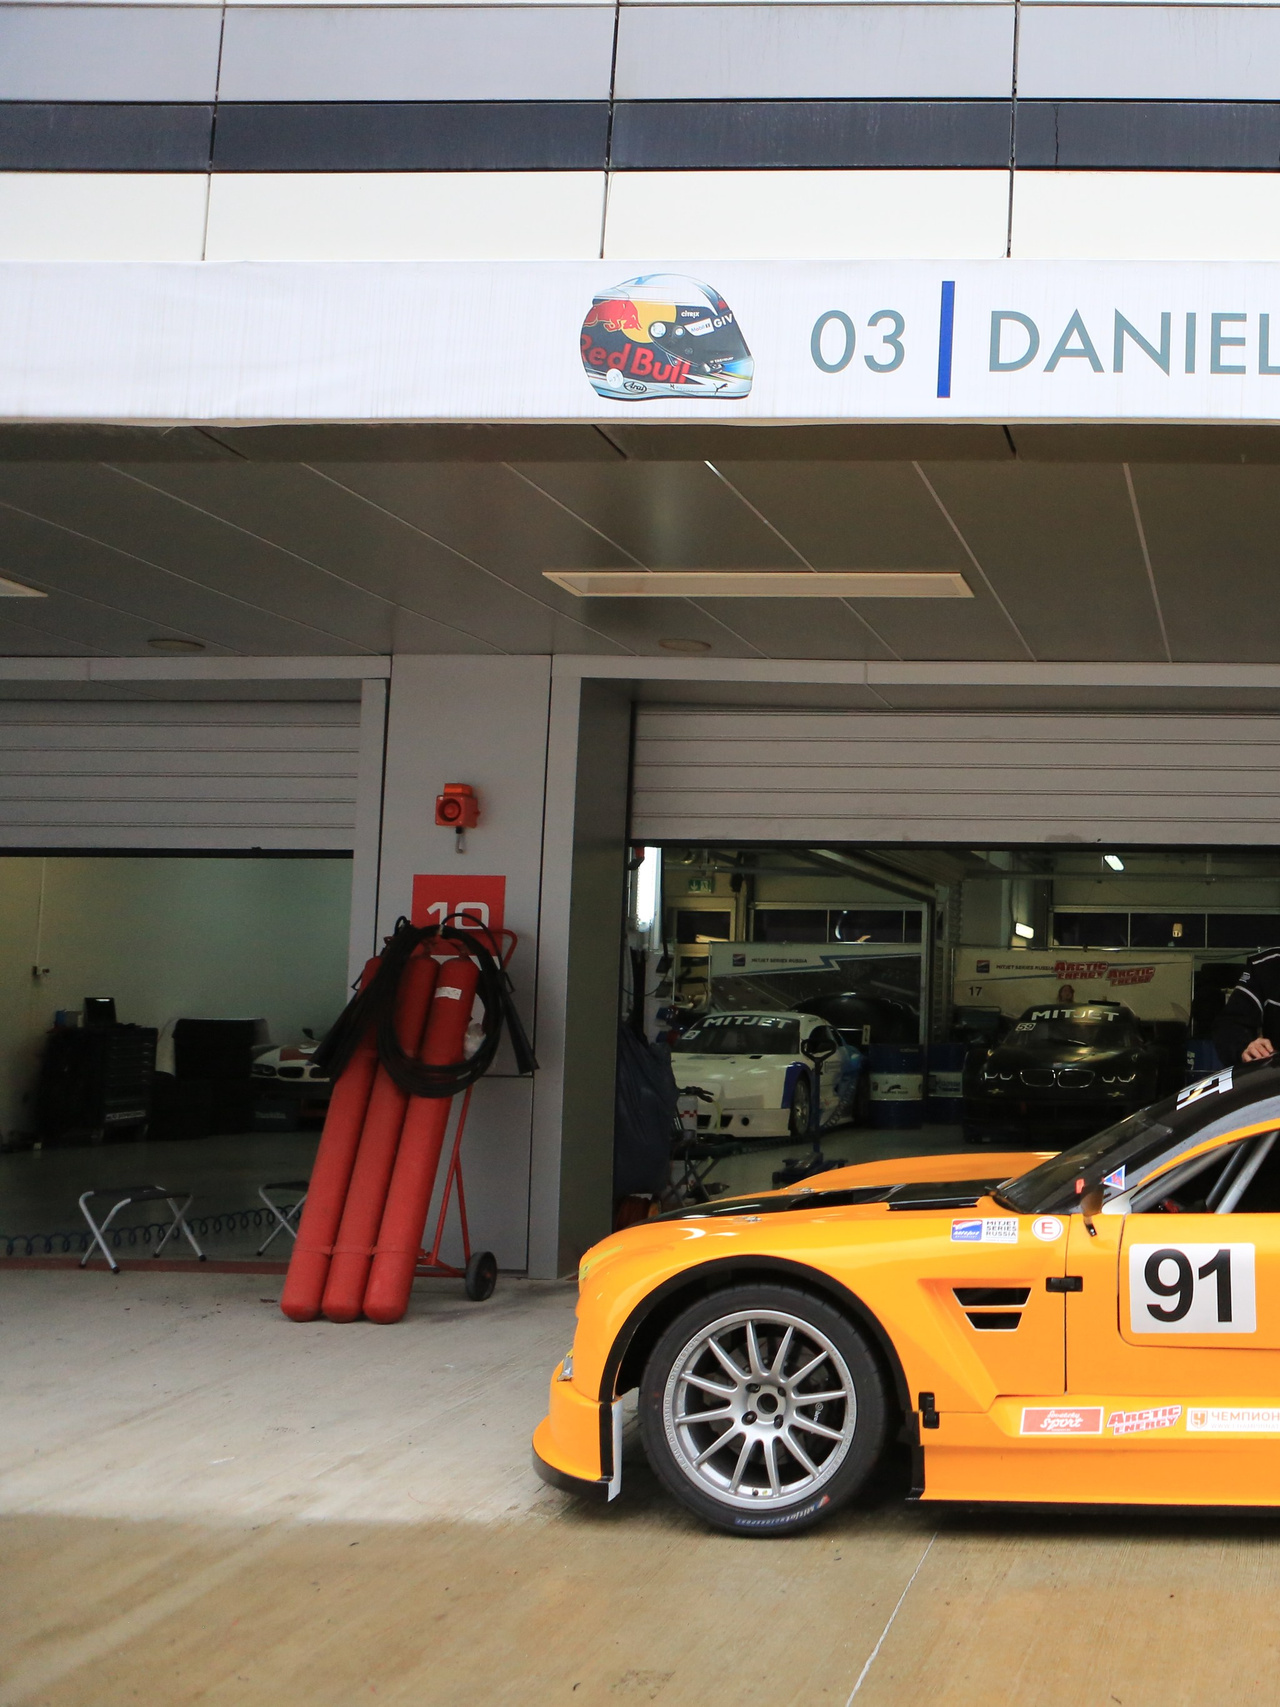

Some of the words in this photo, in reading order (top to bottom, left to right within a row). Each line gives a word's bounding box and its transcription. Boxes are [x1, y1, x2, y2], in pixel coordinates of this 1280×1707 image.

[713, 314, 733, 328] GIV
[810, 309, 906, 374] 03
[629, 347, 692, 384] Bull
[426, 901, 490, 930] 10
[968, 986, 983, 997] 17
[702, 1016, 793, 1030] MITJET
[1031, 1009, 1120, 1022] MITJET
[1041, 1222, 1053, 1234] E
[1144, 1248, 1233, 1323] 91
[1108, 1406, 1181, 1425] ARCTIC
[1114, 1416, 1177, 1434] ENERGY
